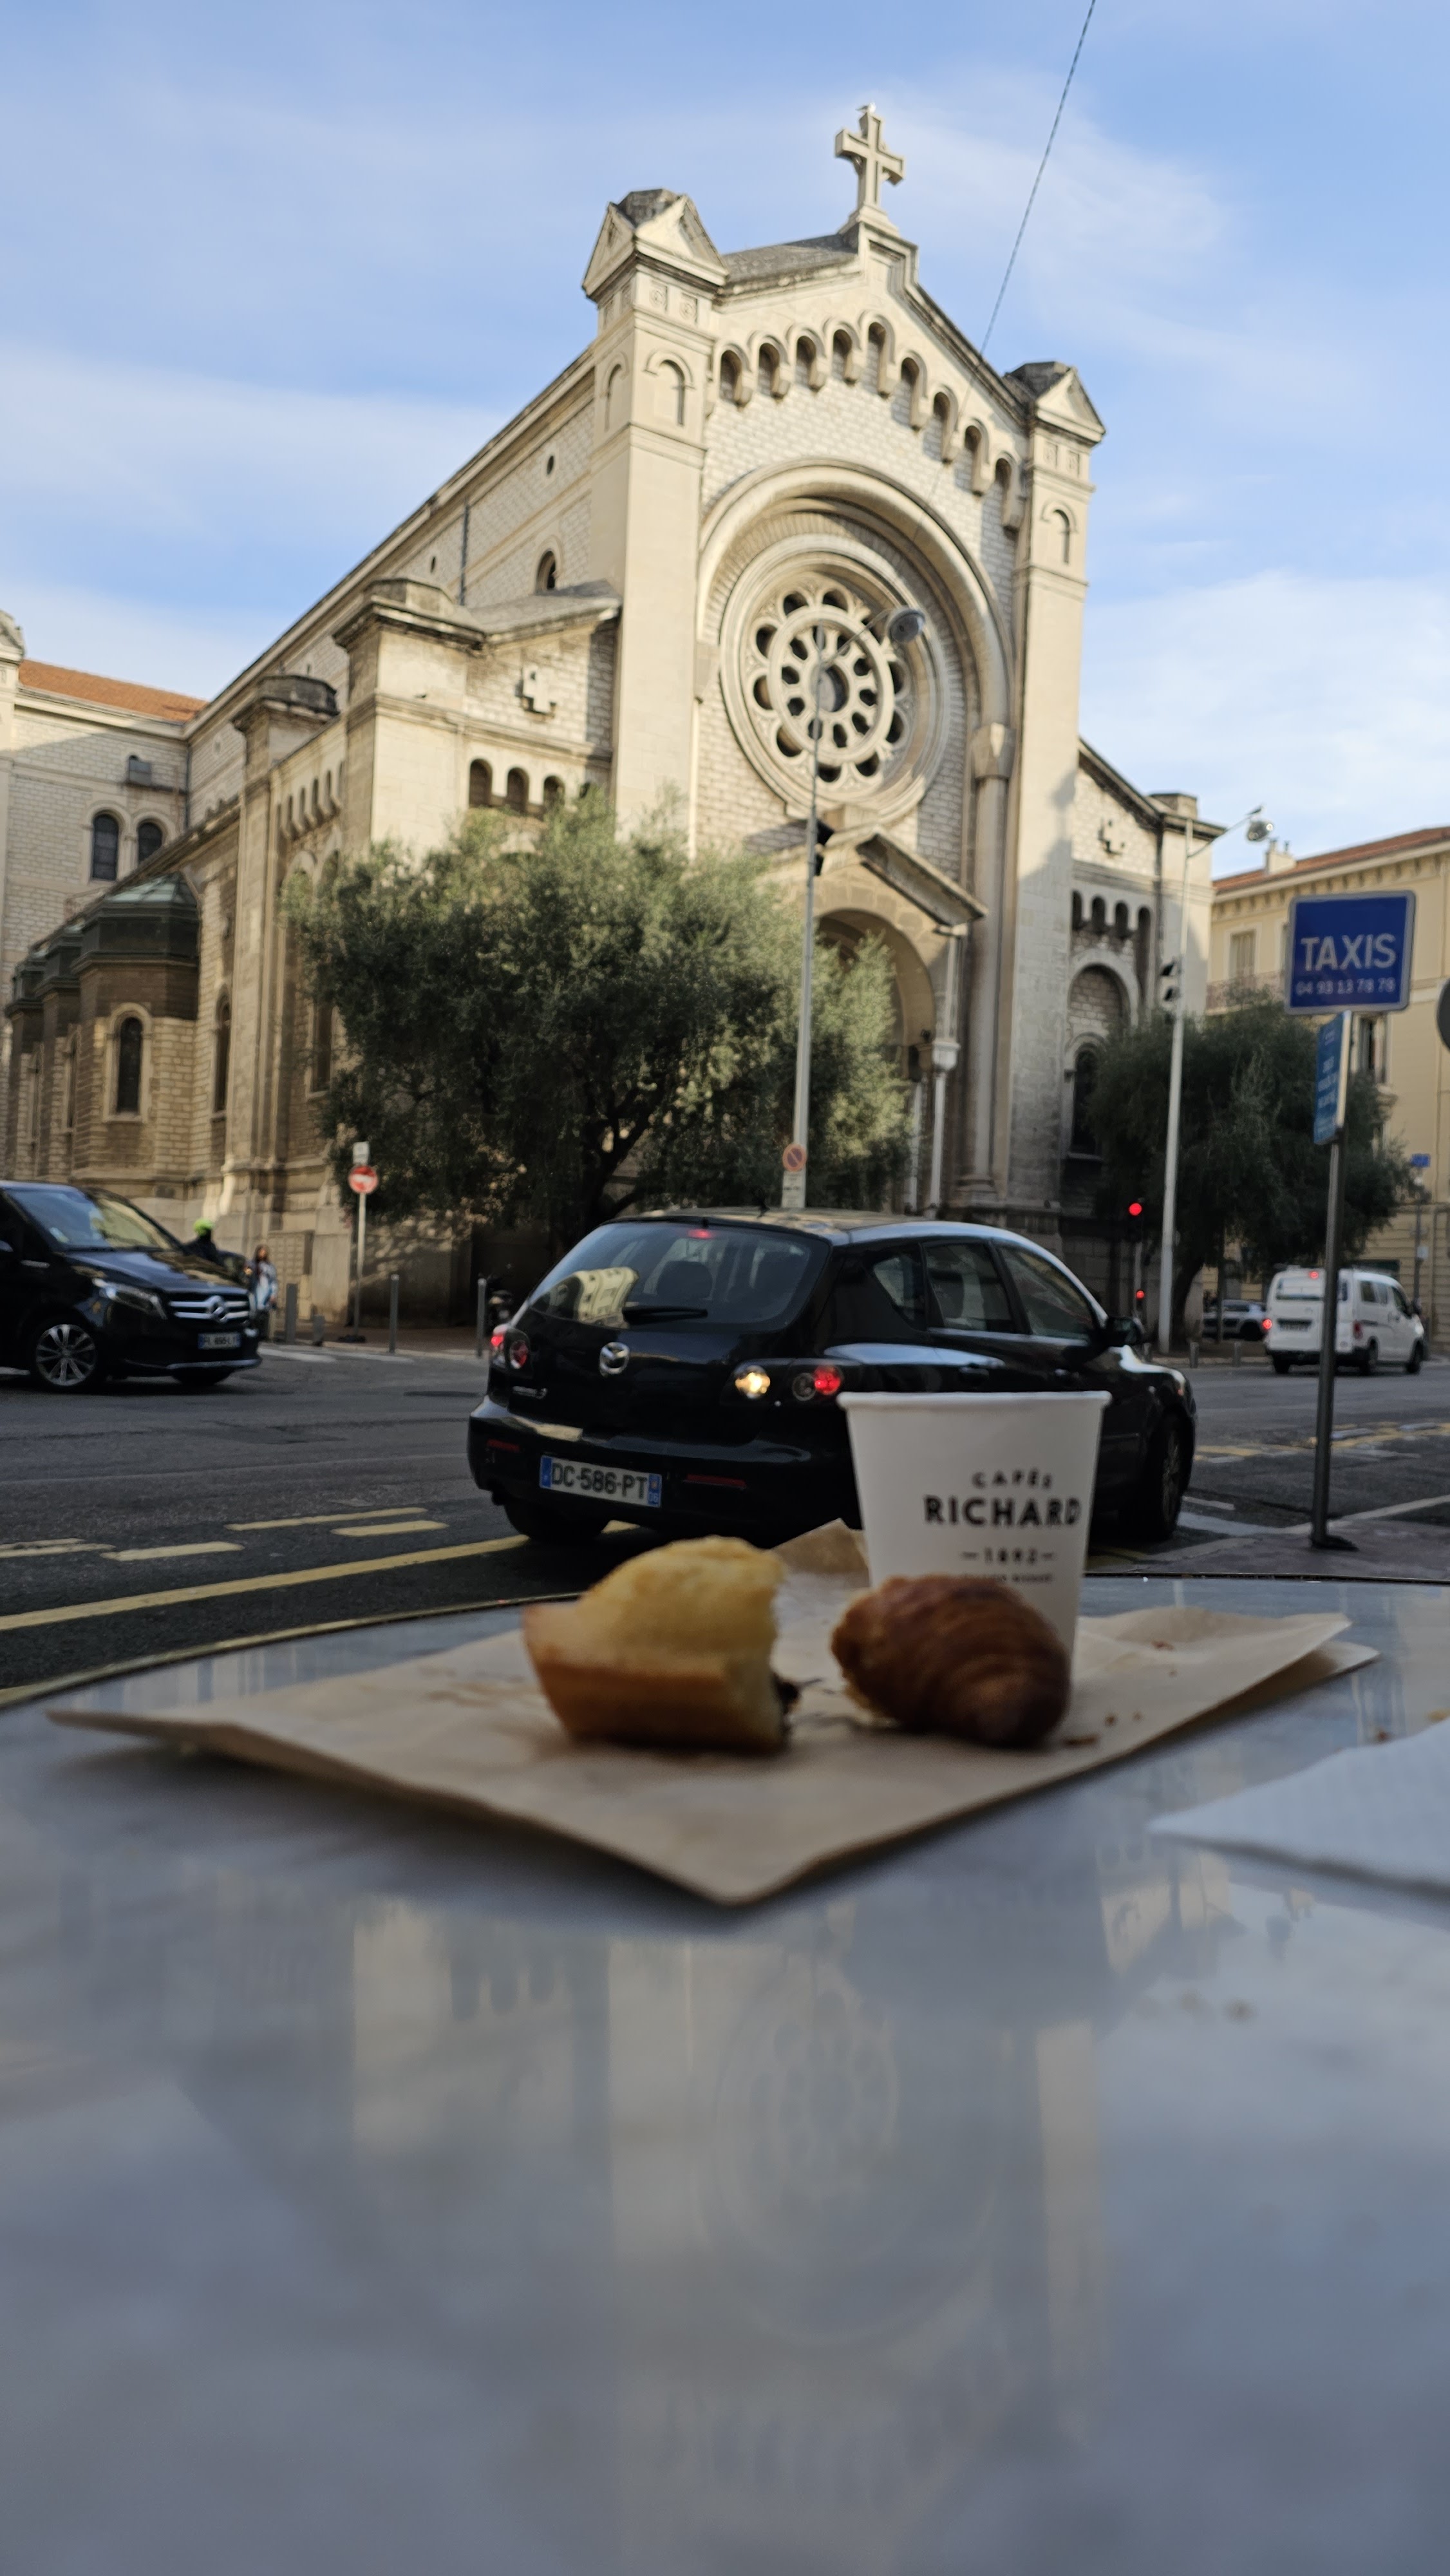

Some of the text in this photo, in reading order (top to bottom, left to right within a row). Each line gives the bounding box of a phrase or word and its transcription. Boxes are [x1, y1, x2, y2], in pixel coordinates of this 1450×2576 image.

[1301, 933, 1397, 971] TAXIS
[1296, 981, 1313, 996] 04
[1337, 979, 1354, 994] 13
[552, 1463, 646, 1499] DC-586-PT
[924, 1495, 1081, 1526] RICHARD
